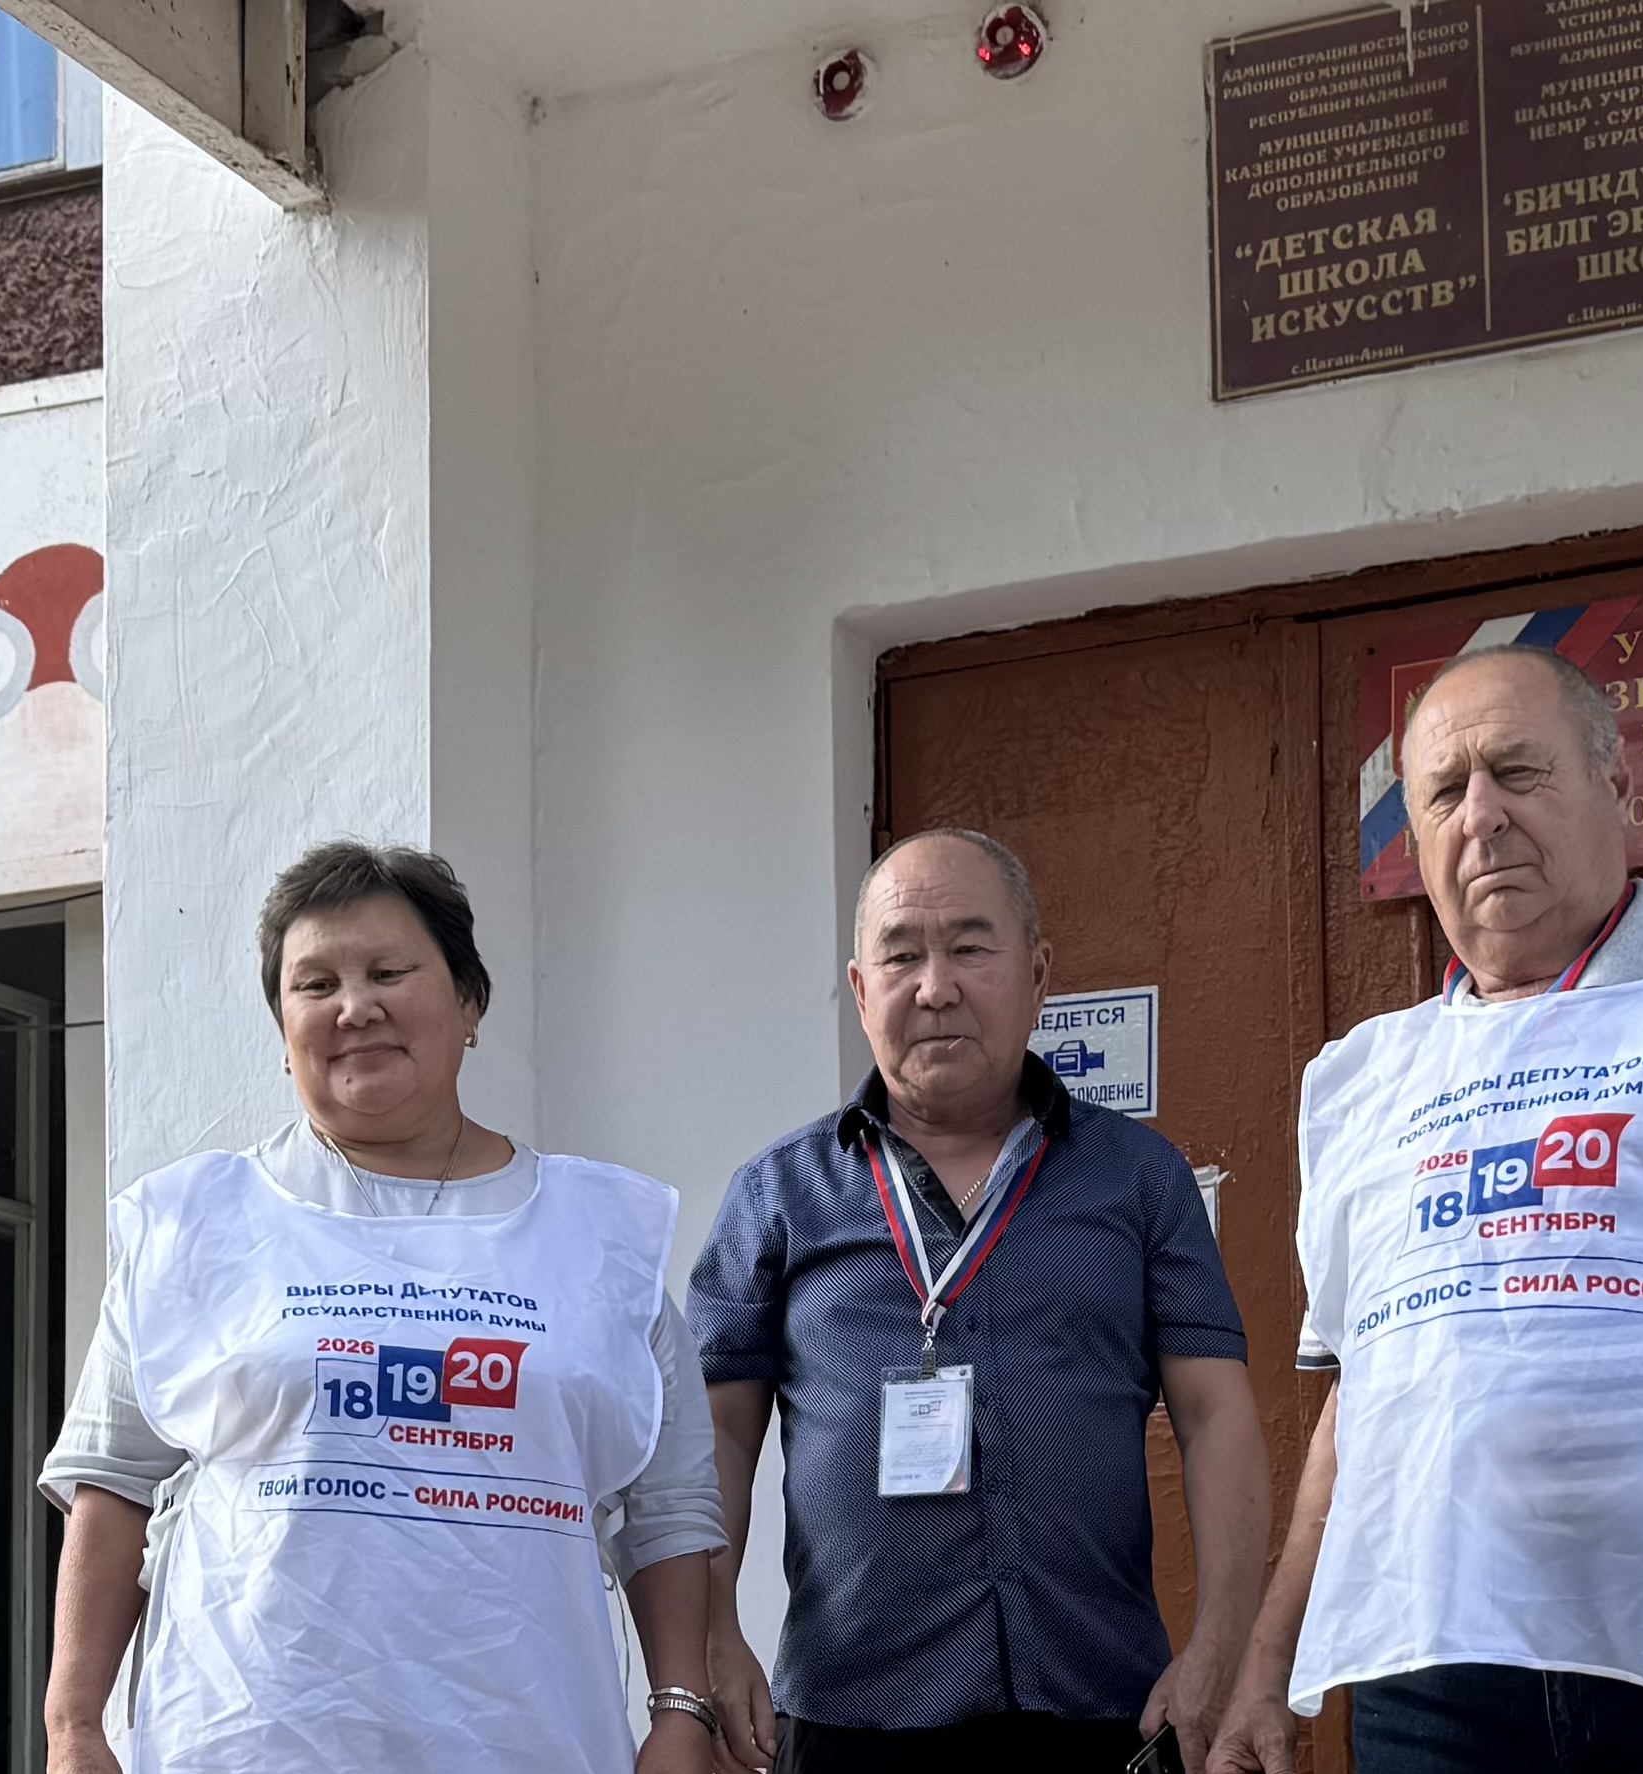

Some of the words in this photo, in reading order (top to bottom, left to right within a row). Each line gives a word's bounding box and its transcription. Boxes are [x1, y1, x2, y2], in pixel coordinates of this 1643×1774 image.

[1510, 19, 1642, 58] МУНИЦИПАЛЬН
[1221, 42, 1358, 83] АДМИНИСТРАЦИЯ
[1223, 65, 1315, 101] РАЙОННОГО
[1317, 38, 1469, 81] МУНИЦИПАЬНОГО
[1248, 98, 1352, 130] РЕСПУБЛИКИ
[1354, 77, 1448, 108] КАЛМЫКИЯ
[1288, 69, 1403, 104] ОБРАЗОВАНИЯ
[1224, 149, 1328, 183] КАЗЕННОЕ
[1333, 119, 1470, 166] УЧРЕЖДЕНИЕ
[1258, 107, 1434, 158] МУНИЦИПАЛЬНОЕ
[1529, 116, 1587, 142] НЕМР
[1247, 144, 1446, 200] ДОПОЛНИТЕЛЬНОГО
[1276, 170, 1419, 212] ОБРАЗОВАНИЯ
[1505, 215, 1598, 257] БИЛГ
[1278, 248, 1426, 300] ШКОЛА
[1397, 1087, 1590, 1149] ГОСУДАРСТВЕННОЙ
[1408, 1074, 1502, 1123] ВЫБОРЫ
[1415, 1149, 1468, 1177] 2026
[1415, 1191, 1463, 1233] 18
[1477, 1158, 1528, 1200] 19
[1541, 1128, 1611, 1170] 20
[1478, 1211, 1615, 1239] СЕНТЯБРЯ
[286, 1283, 393, 1297] ВЫБОРЫ
[1354, 1301, 1391, 1341] ВОЙ
[1396, 1280, 1473, 1316] ГОЛОС
[1503, 1273, 1579, 1295] СИЛА
[282, 1305, 483, 1323] ГОСУДАРСТВЕННОЙ
[488, 1313, 547, 1333] ДУМЫ
[317, 1337, 375, 1355] 2026
[323, 1378, 374, 1419] 18
[386, 1362, 437, 1404] 19
[449, 1351, 512, 1391] 20
[388, 1424, 514, 1453] СЕНТЯБРЯ
[258, 1474, 298, 1498] ТВОЙ
[303, 1477, 386, 1499] ГОЛОС
[413, 1486, 479, 1510] СИЛА
[485, 1493, 584, 1524] РОССИИ!
